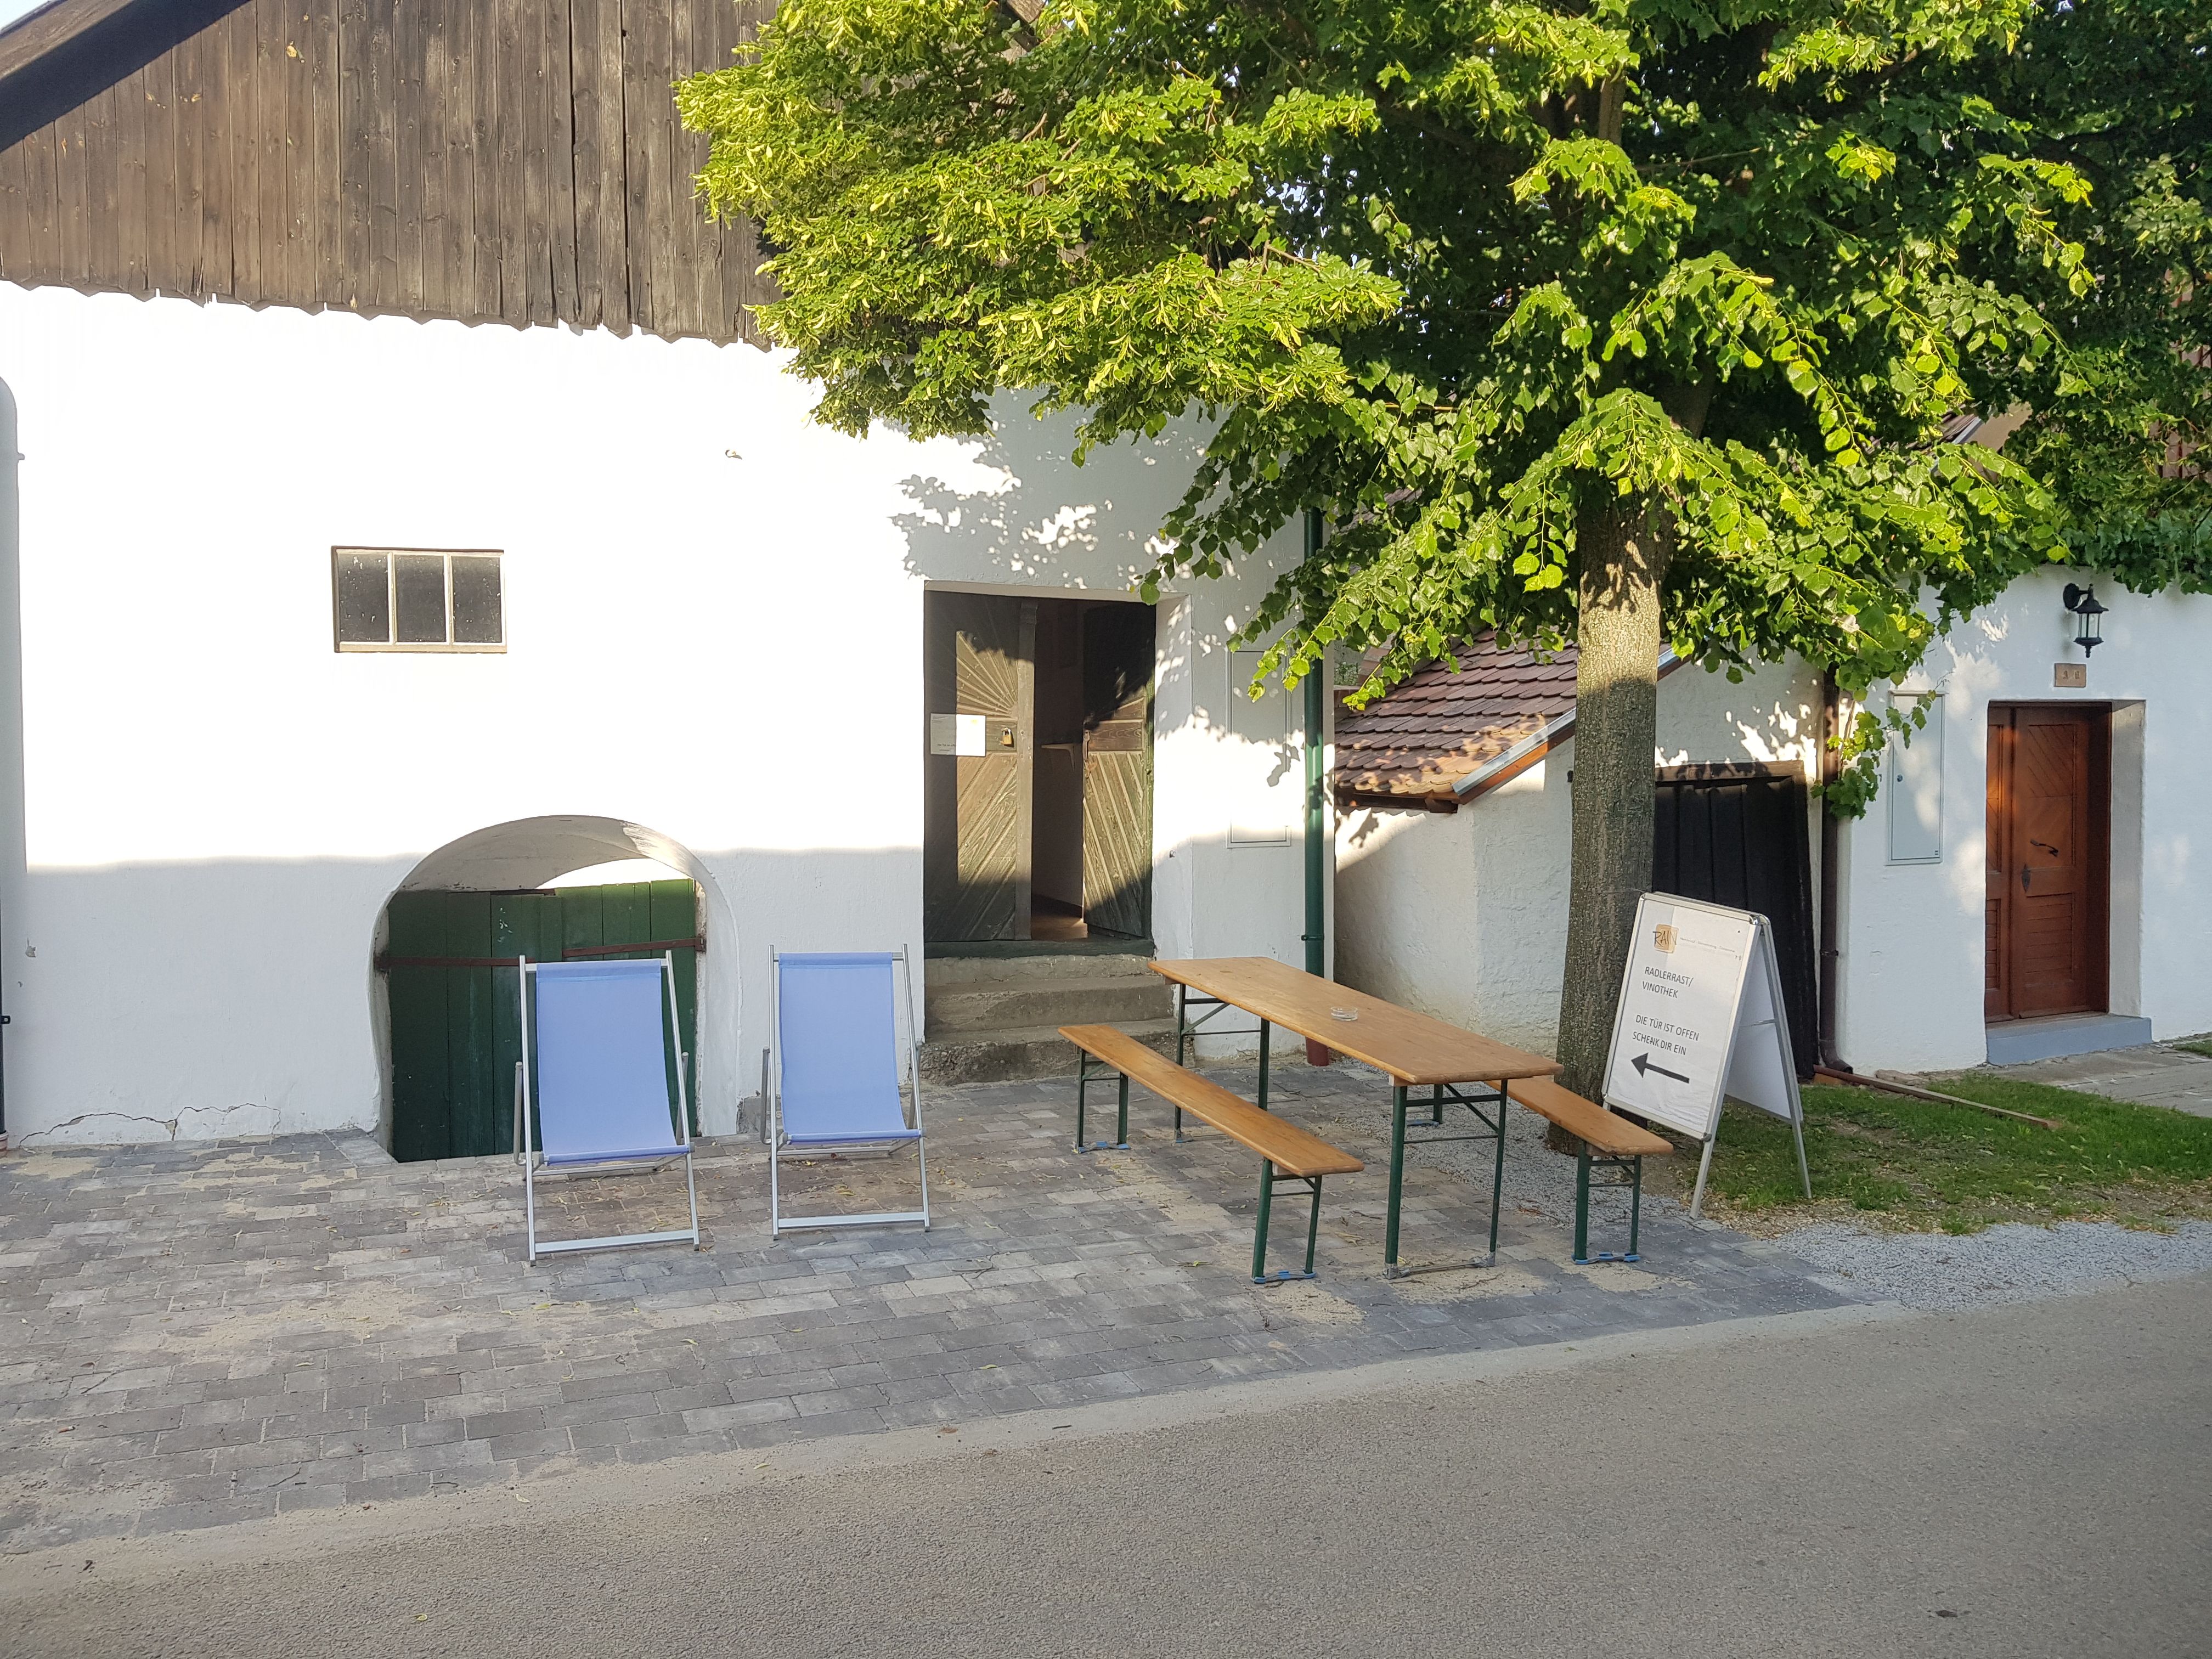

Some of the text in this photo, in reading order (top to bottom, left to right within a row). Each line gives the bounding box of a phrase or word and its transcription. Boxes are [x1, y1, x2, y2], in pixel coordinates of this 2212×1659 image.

[1652, 930, 1677, 946] RAIN
[1645, 966, 1694, 987] RADLERRAST/
[1643, 981, 1679, 998] VINOTHEK
[1635, 1014, 1700, 1041] DIE TÜR IST OFFEN
[1632, 1031, 1686, 1056] SCHENK DIR EIN
